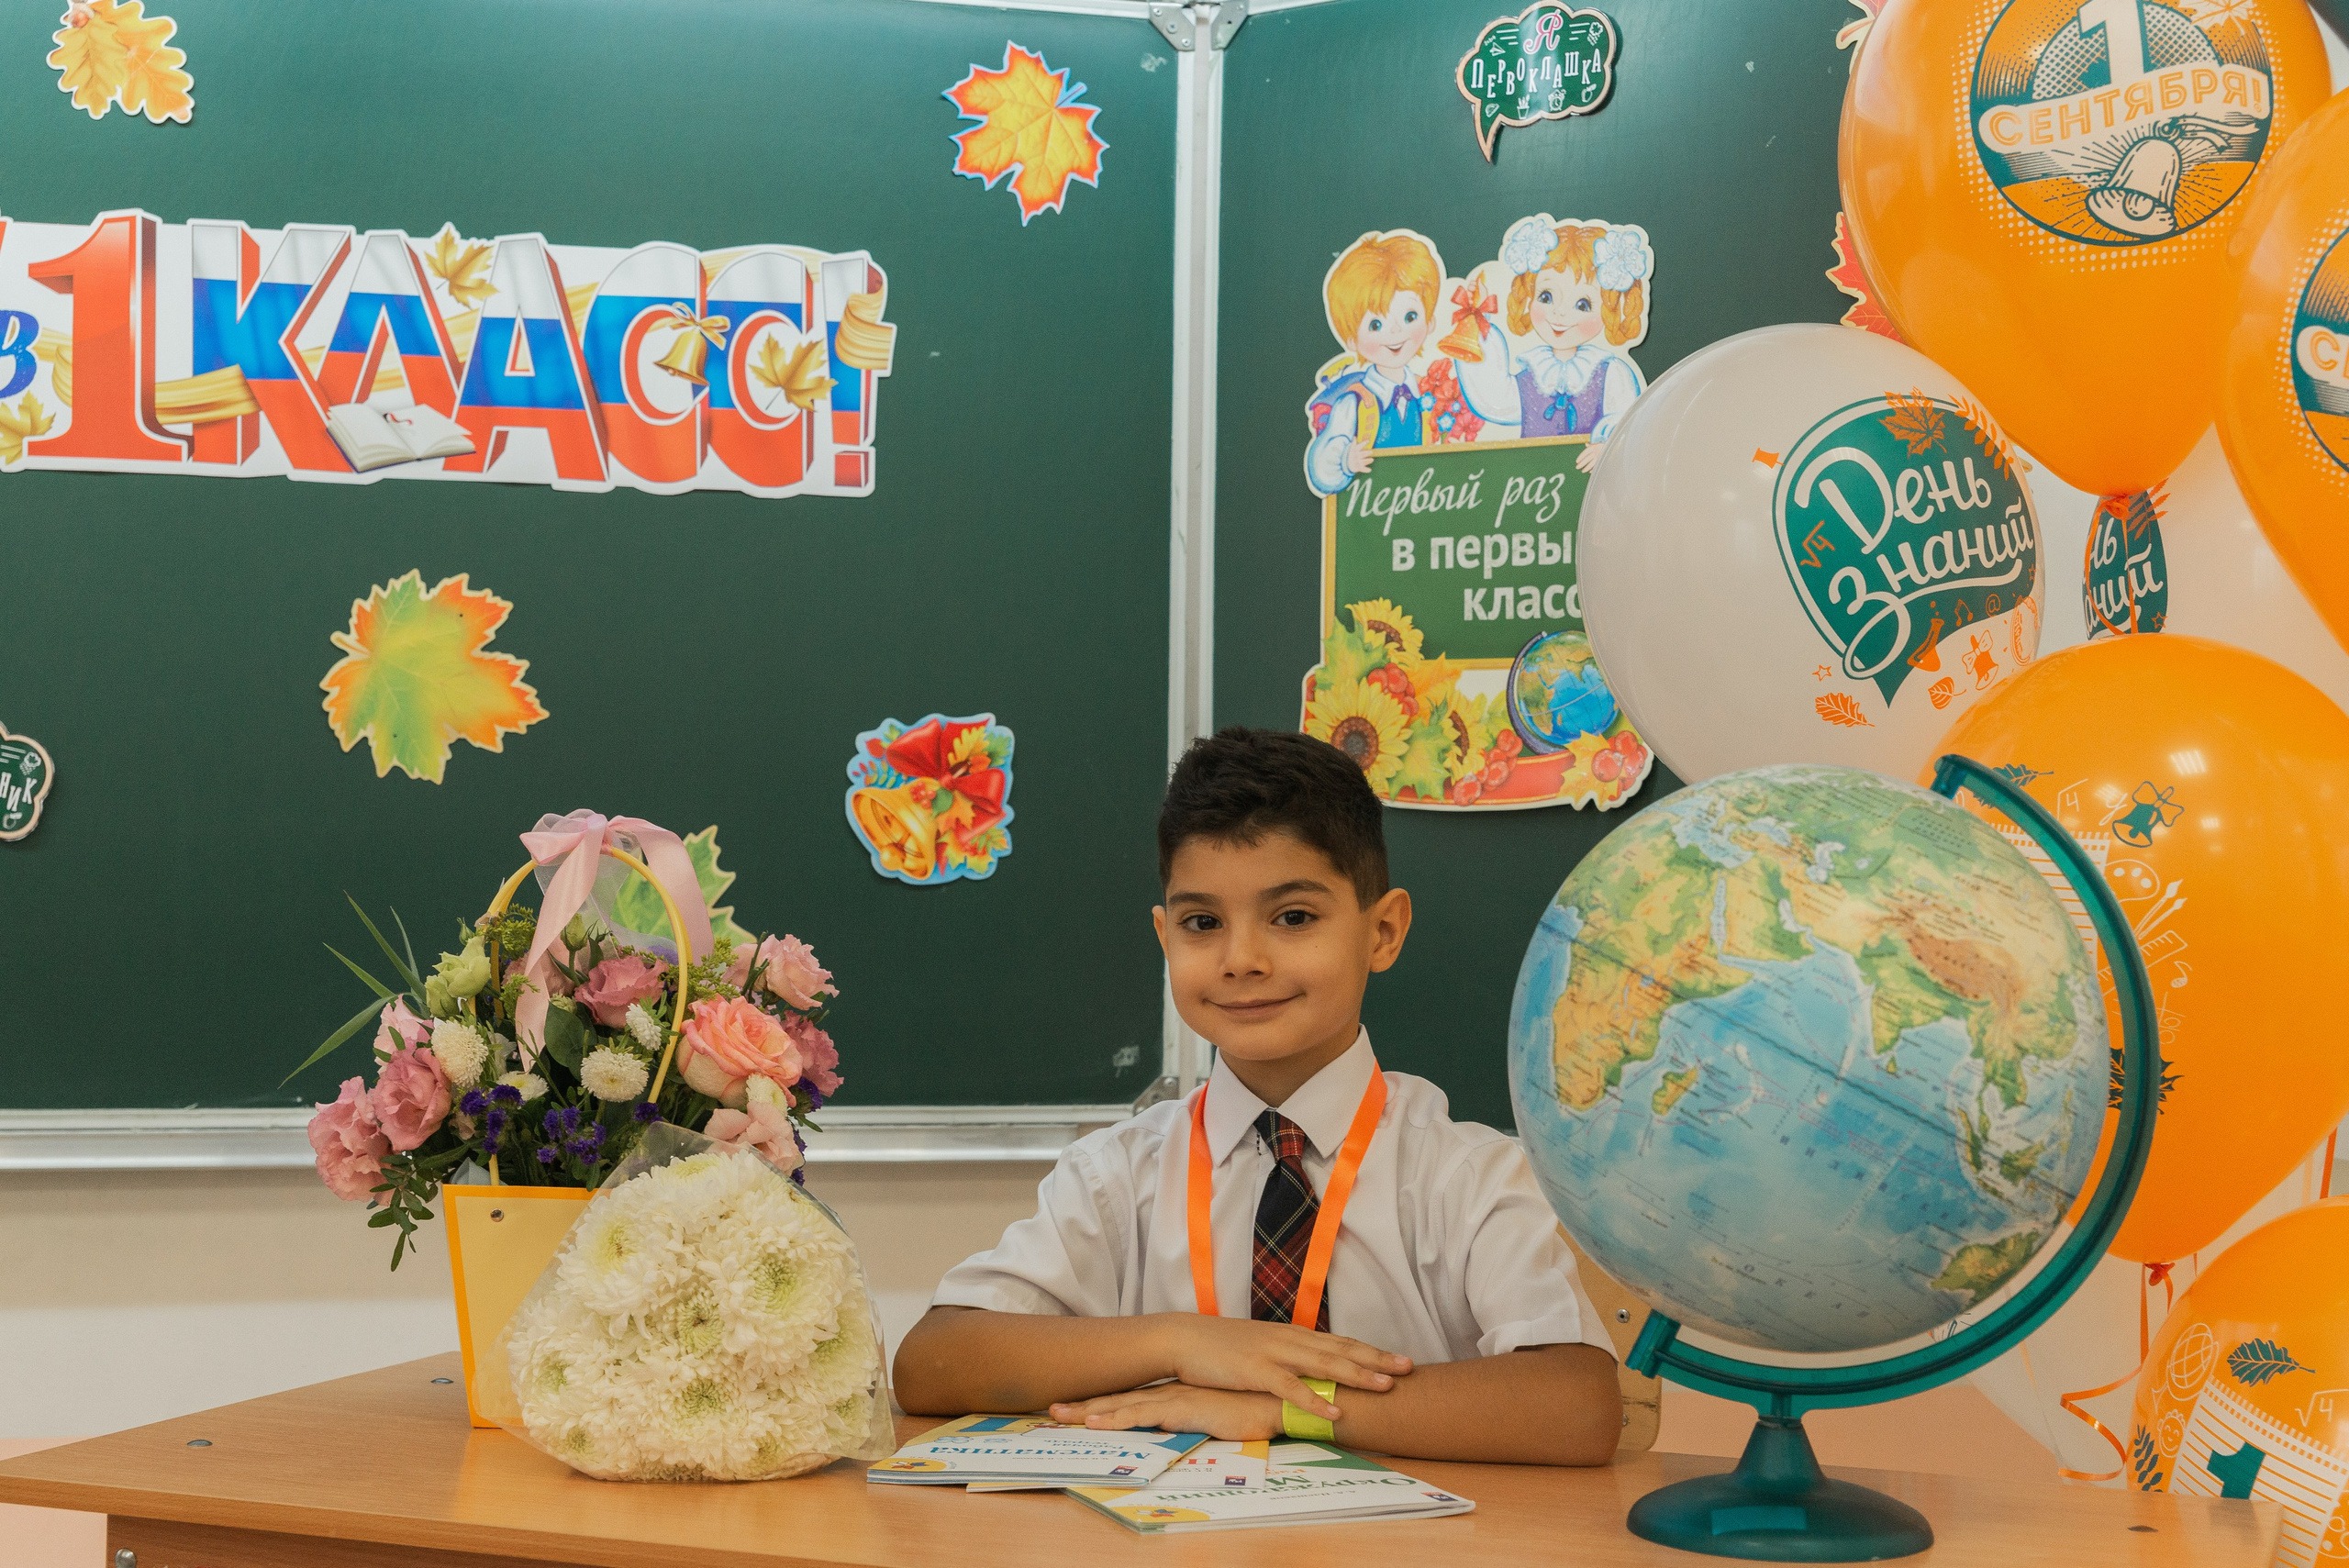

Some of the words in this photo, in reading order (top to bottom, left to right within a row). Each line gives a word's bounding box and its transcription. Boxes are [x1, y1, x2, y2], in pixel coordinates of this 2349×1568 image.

[1523, 9, 1564, 54] Я
[1471, 49, 1601, 98] ПЕРВОКЛАШКА
[1988, 68, 2263, 147] СЕНТЯБРЯ!
[28, 216, 191, 462] 1
[191, 228, 876, 489] КЛАСС!
[1345, 467, 1485, 536] Первый
[1494, 469, 1565, 528] раз
[1794, 447, 1992, 554] День
[1392, 538, 1416, 572] в
[1430, 530, 1577, 580] первы
[2087, 517, 2117, 569] нь
[1829, 496, 2033, 678] Знаний
[2084, 543, 2164, 637] аний
[0, 772, 38, 812] НИК
[930, 1447, 1154, 1460] Математика
